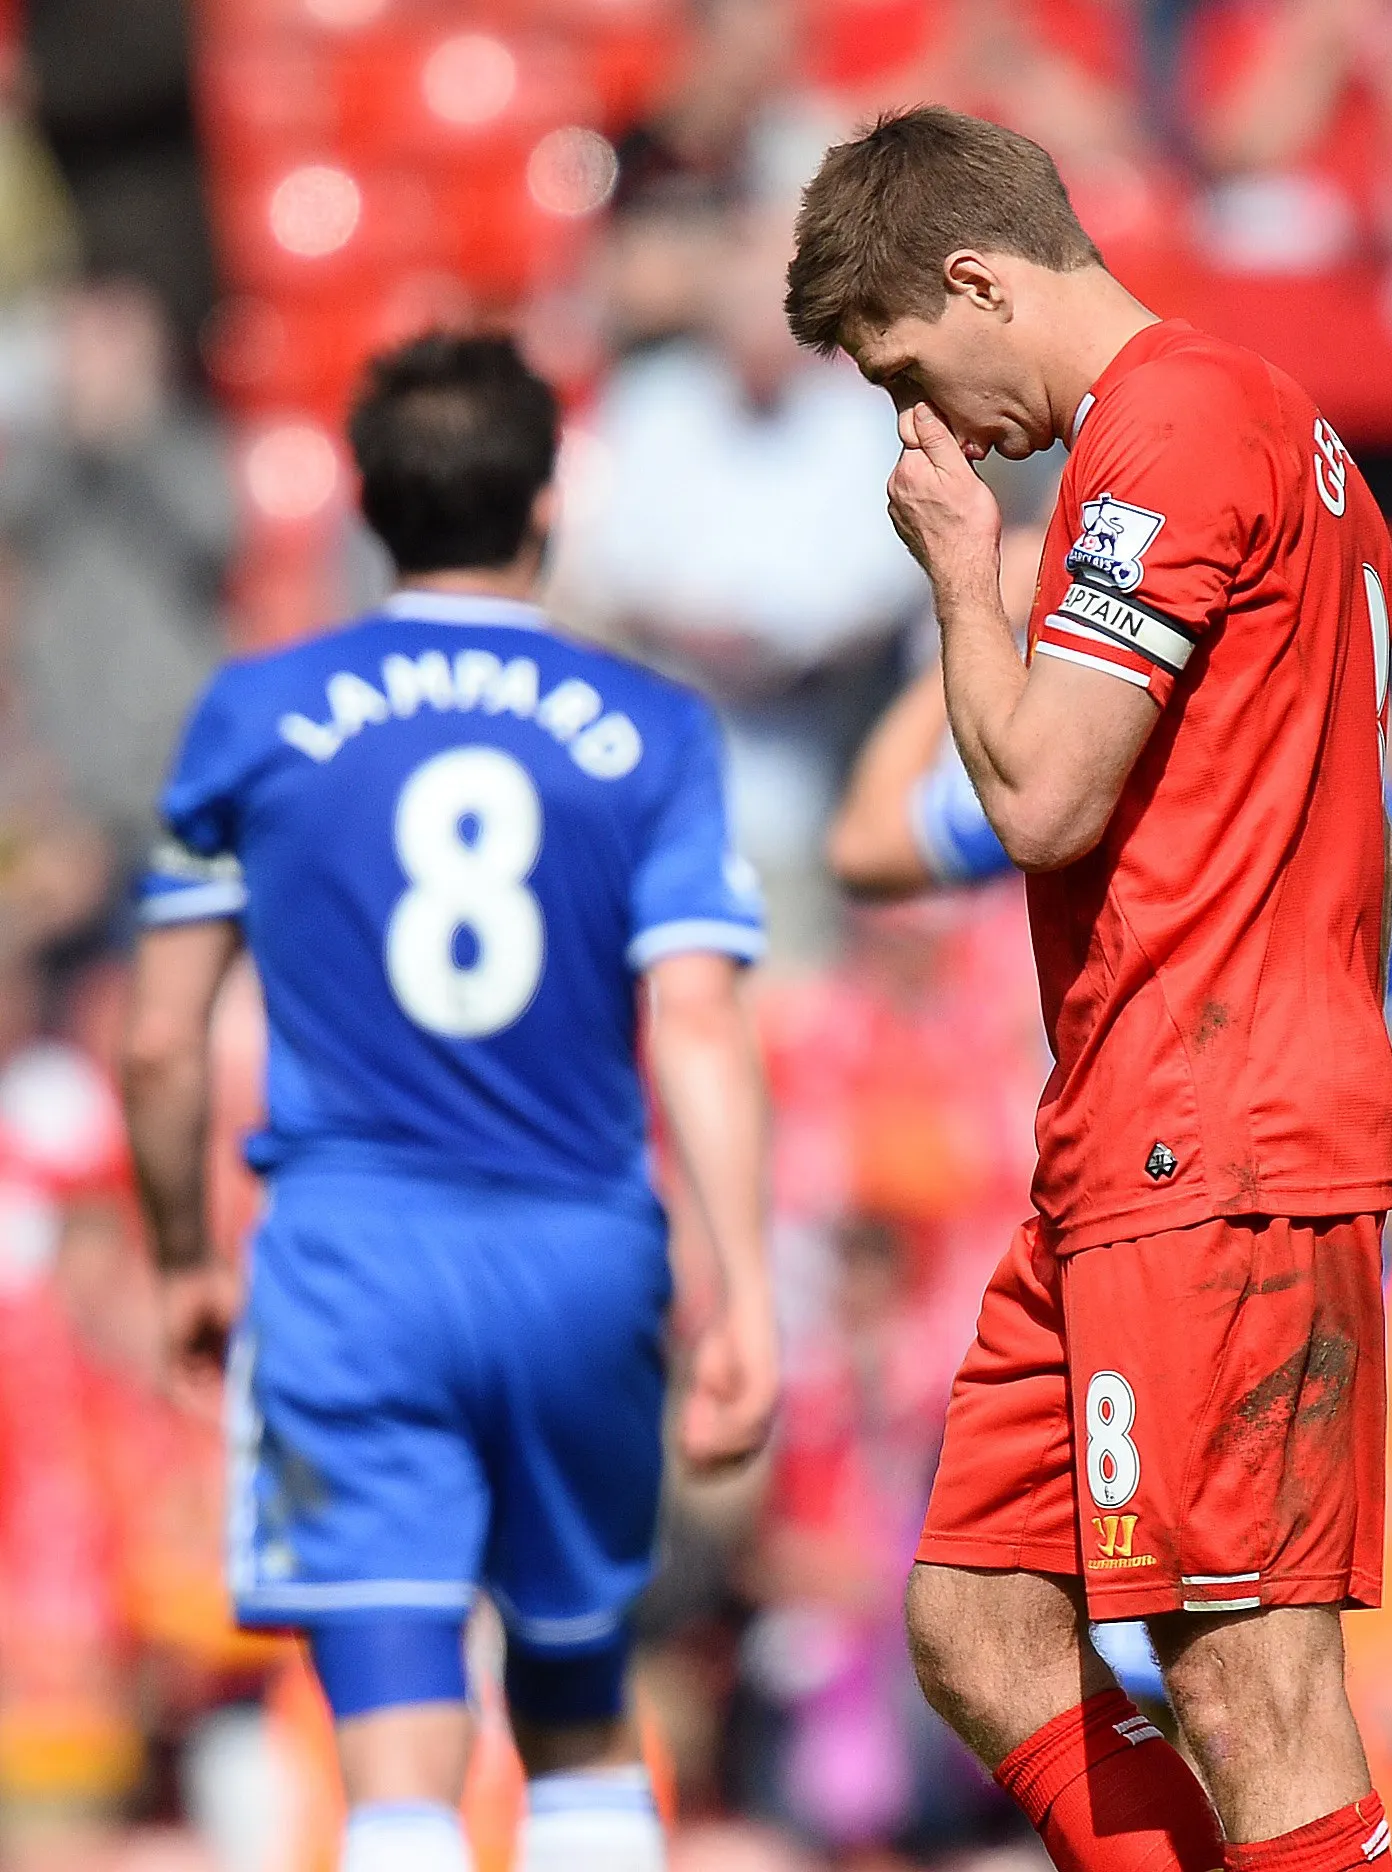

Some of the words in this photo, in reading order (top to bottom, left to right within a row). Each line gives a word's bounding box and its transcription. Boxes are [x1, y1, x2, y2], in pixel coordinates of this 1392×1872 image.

[278, 649, 643, 781] LAMPARD
[386, 744, 546, 1040] 8
[1086, 1370, 1140, 1509] 8
[1088, 1555, 1153, 1569] WARRIOR
